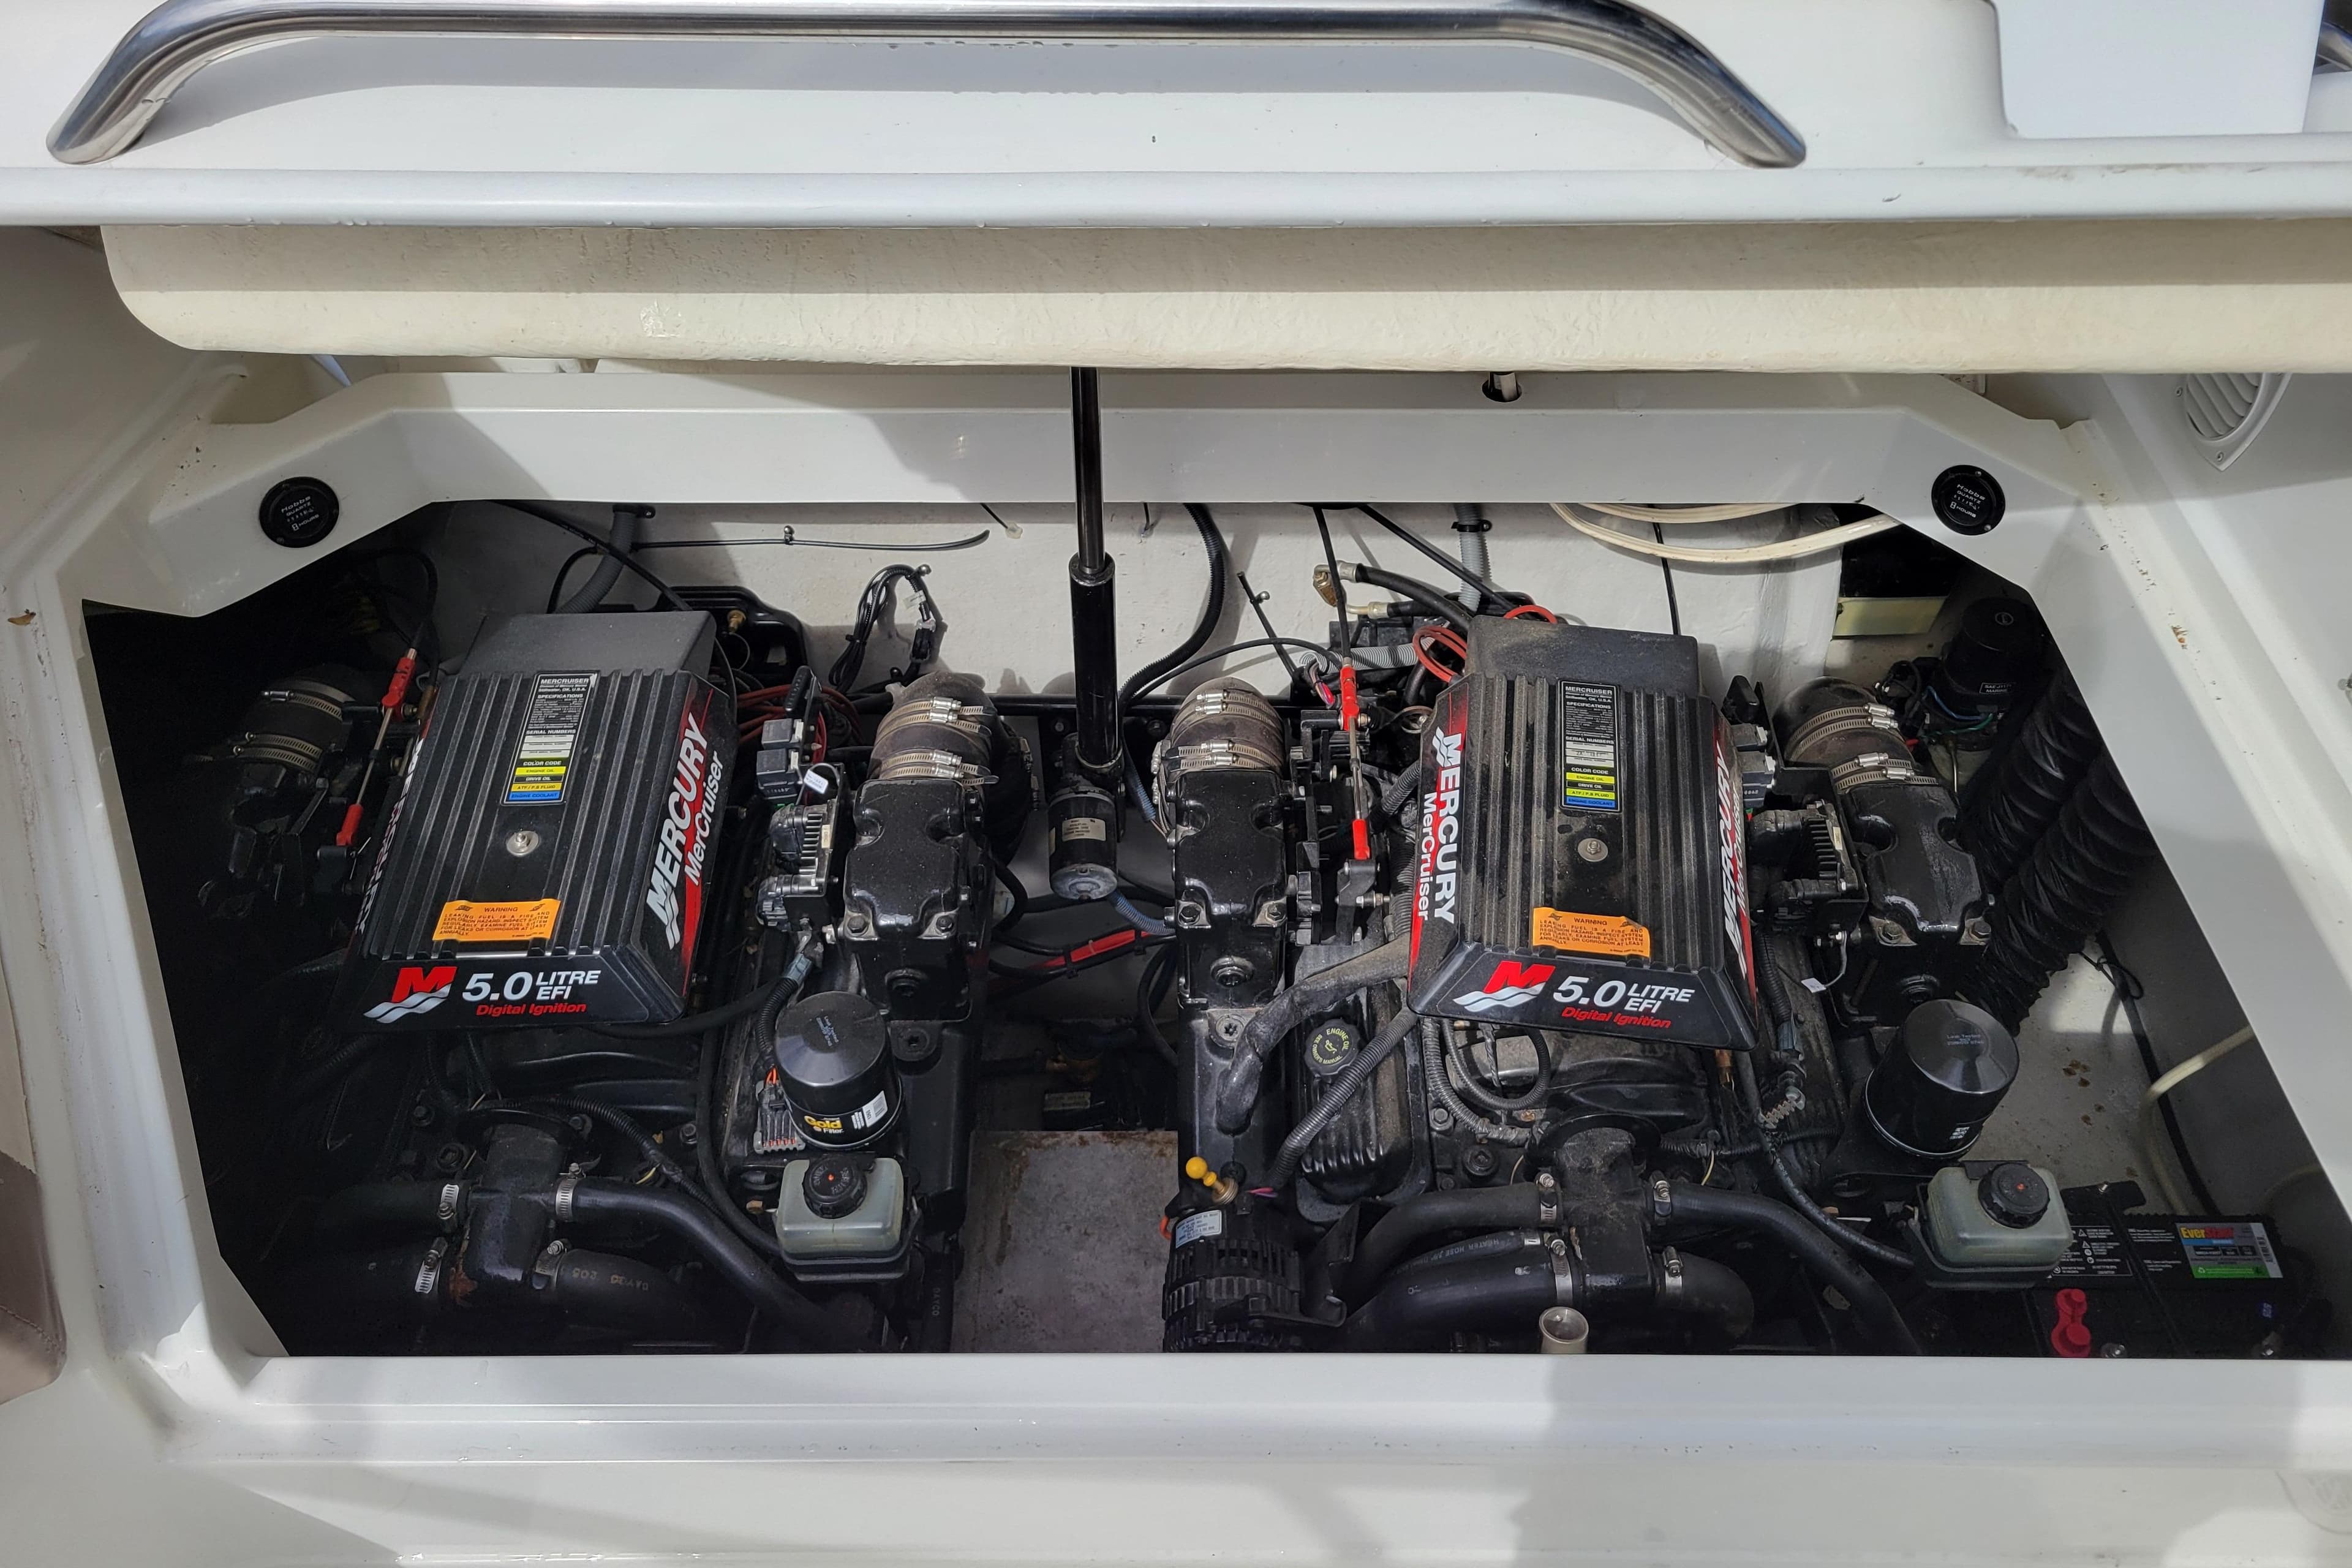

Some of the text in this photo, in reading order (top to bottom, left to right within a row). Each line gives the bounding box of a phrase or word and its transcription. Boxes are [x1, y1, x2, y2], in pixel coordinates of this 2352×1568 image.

[1957, 484, 1985, 500] Hobbs
[1957, 491, 1981, 504] QUARTZ
[281, 496, 311, 513] Hobbs
[286, 502, 311, 516] QUARTZ
[1956, 506, 1976, 518] HOURS
[1565, 686, 1613, 695] MERCRUISER
[646, 712, 707, 926] MERCURY
[684, 750, 723, 886] MerCruiser
[1433, 732, 1463, 924] MERCURY
[1717, 739, 1743, 957] MERCURY
[1732, 780, 1747, 918] MerCruiser
[1418, 792, 1438, 922] MerCruiser
[1574, 917, 1608, 926] WARNING
[462, 970, 601, 1001] 5.0 LITRE
[535, 985, 573, 1001] EFI
[1553, 976, 1696, 1008] 5.0 LITRE
[476, 1002, 587, 1017] Digital Ignition
[1624, 998, 1663, 1014] EFI
[1561, 1006, 1672, 1029] Digital Ignition
[1326, 1028, 1350, 1051] ENGINE OIL
[1314, 1034, 1323, 1044] SEE
[1322, 1055, 1343, 1065] MANUAL
[804, 1115, 843, 1129] Gold
[1445, 1246, 1464, 1256] HOSE
